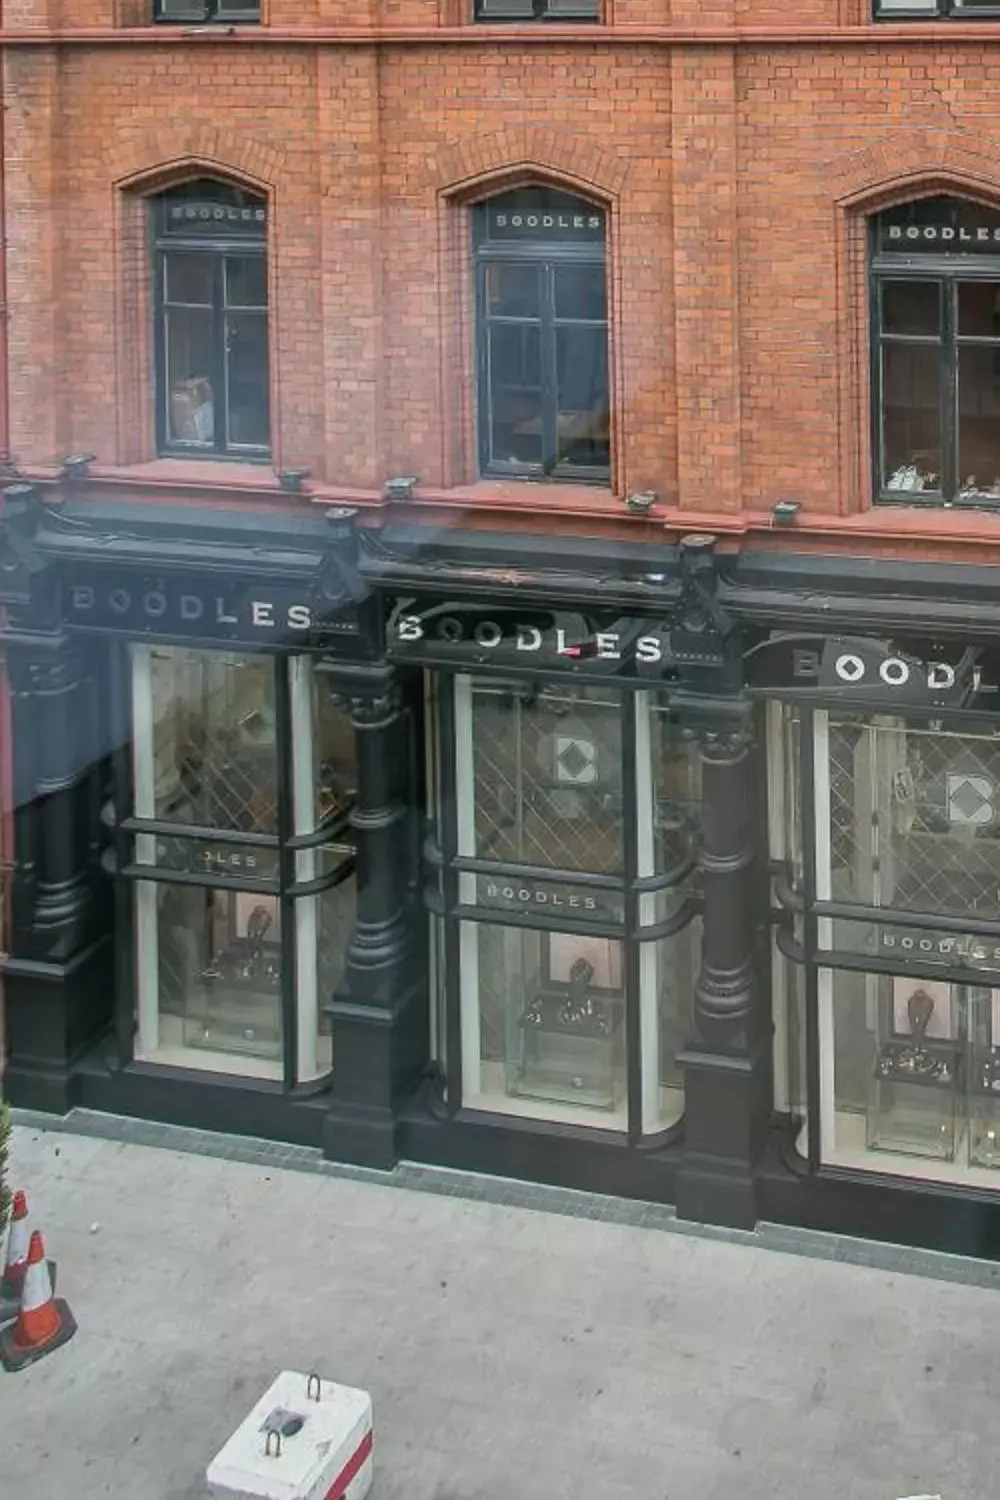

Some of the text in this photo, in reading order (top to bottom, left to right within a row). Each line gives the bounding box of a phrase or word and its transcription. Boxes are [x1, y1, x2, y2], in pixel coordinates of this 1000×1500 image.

[496, 215, 600, 229] BOODLES
[73, 586, 311, 629] BOODLES
[399, 616, 661, 661] BOODLES
[487, 883, 596, 909] BOODLES
